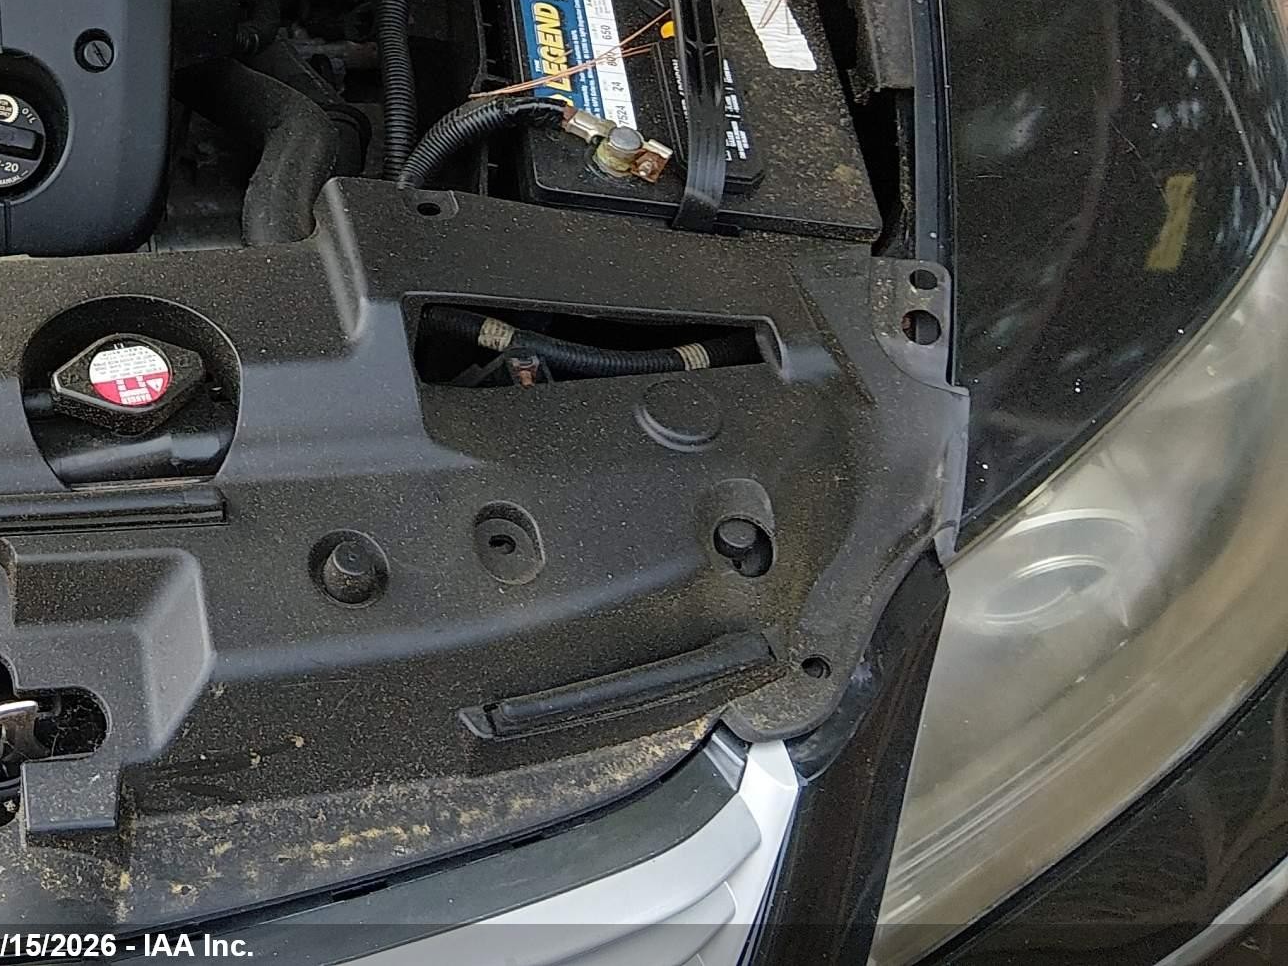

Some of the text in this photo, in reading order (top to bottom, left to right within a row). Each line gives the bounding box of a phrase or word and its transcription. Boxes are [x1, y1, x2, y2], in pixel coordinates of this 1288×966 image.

[600, 25, 613, 40] 650
[534, 2, 571, 91] LEGEND
[611, 81, 623, 92] 24
[22, 108, 37, 124] OIL
[615, 105, 630, 125] 7524
